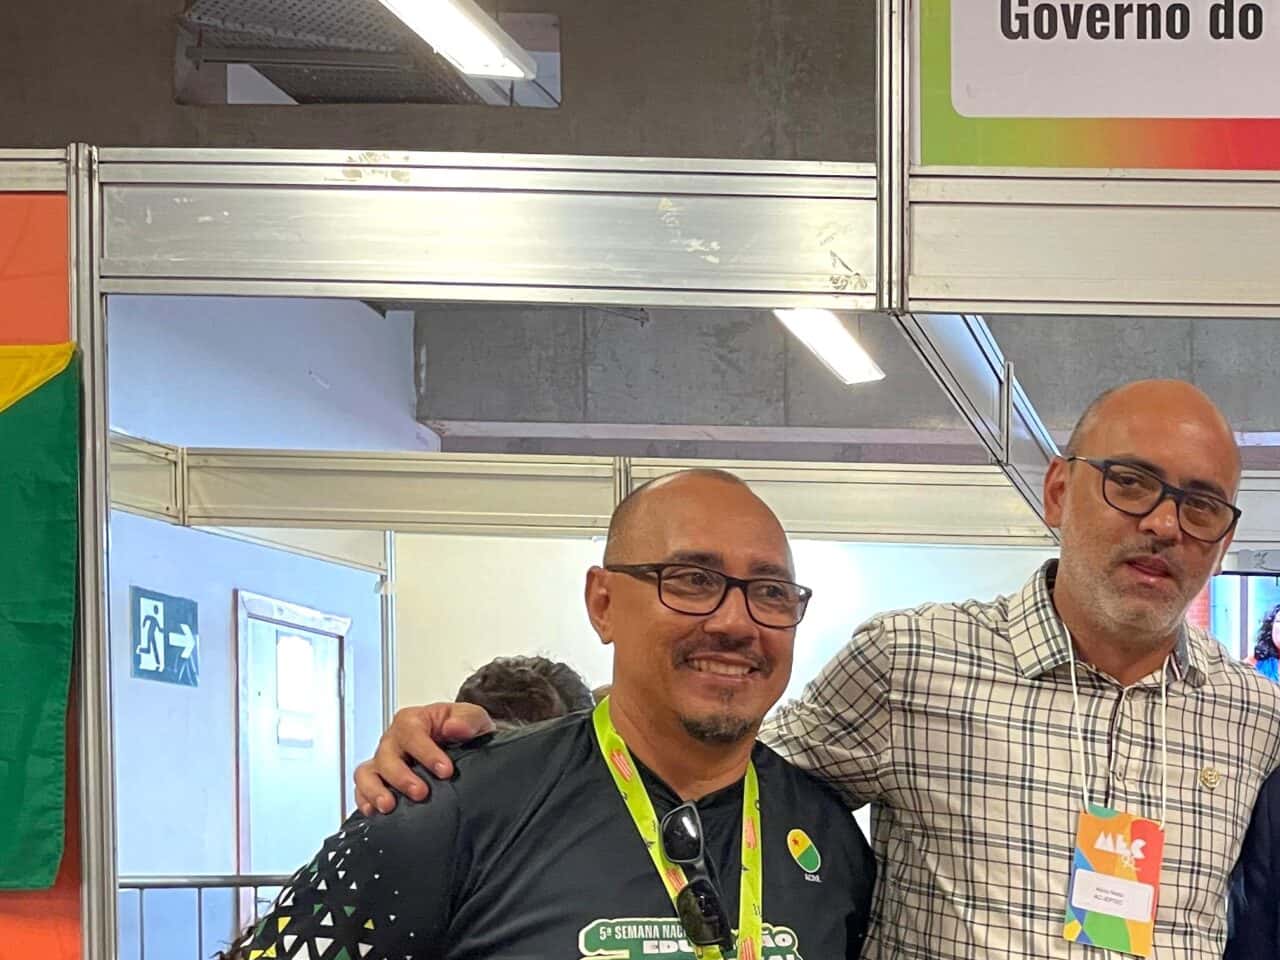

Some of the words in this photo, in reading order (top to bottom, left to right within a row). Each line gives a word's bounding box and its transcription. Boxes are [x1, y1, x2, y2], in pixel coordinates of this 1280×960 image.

[1000, 0, 1191, 40] Governo
[1209, 0, 1263, 40] do
[614, 925, 660, 940] SEMANA
